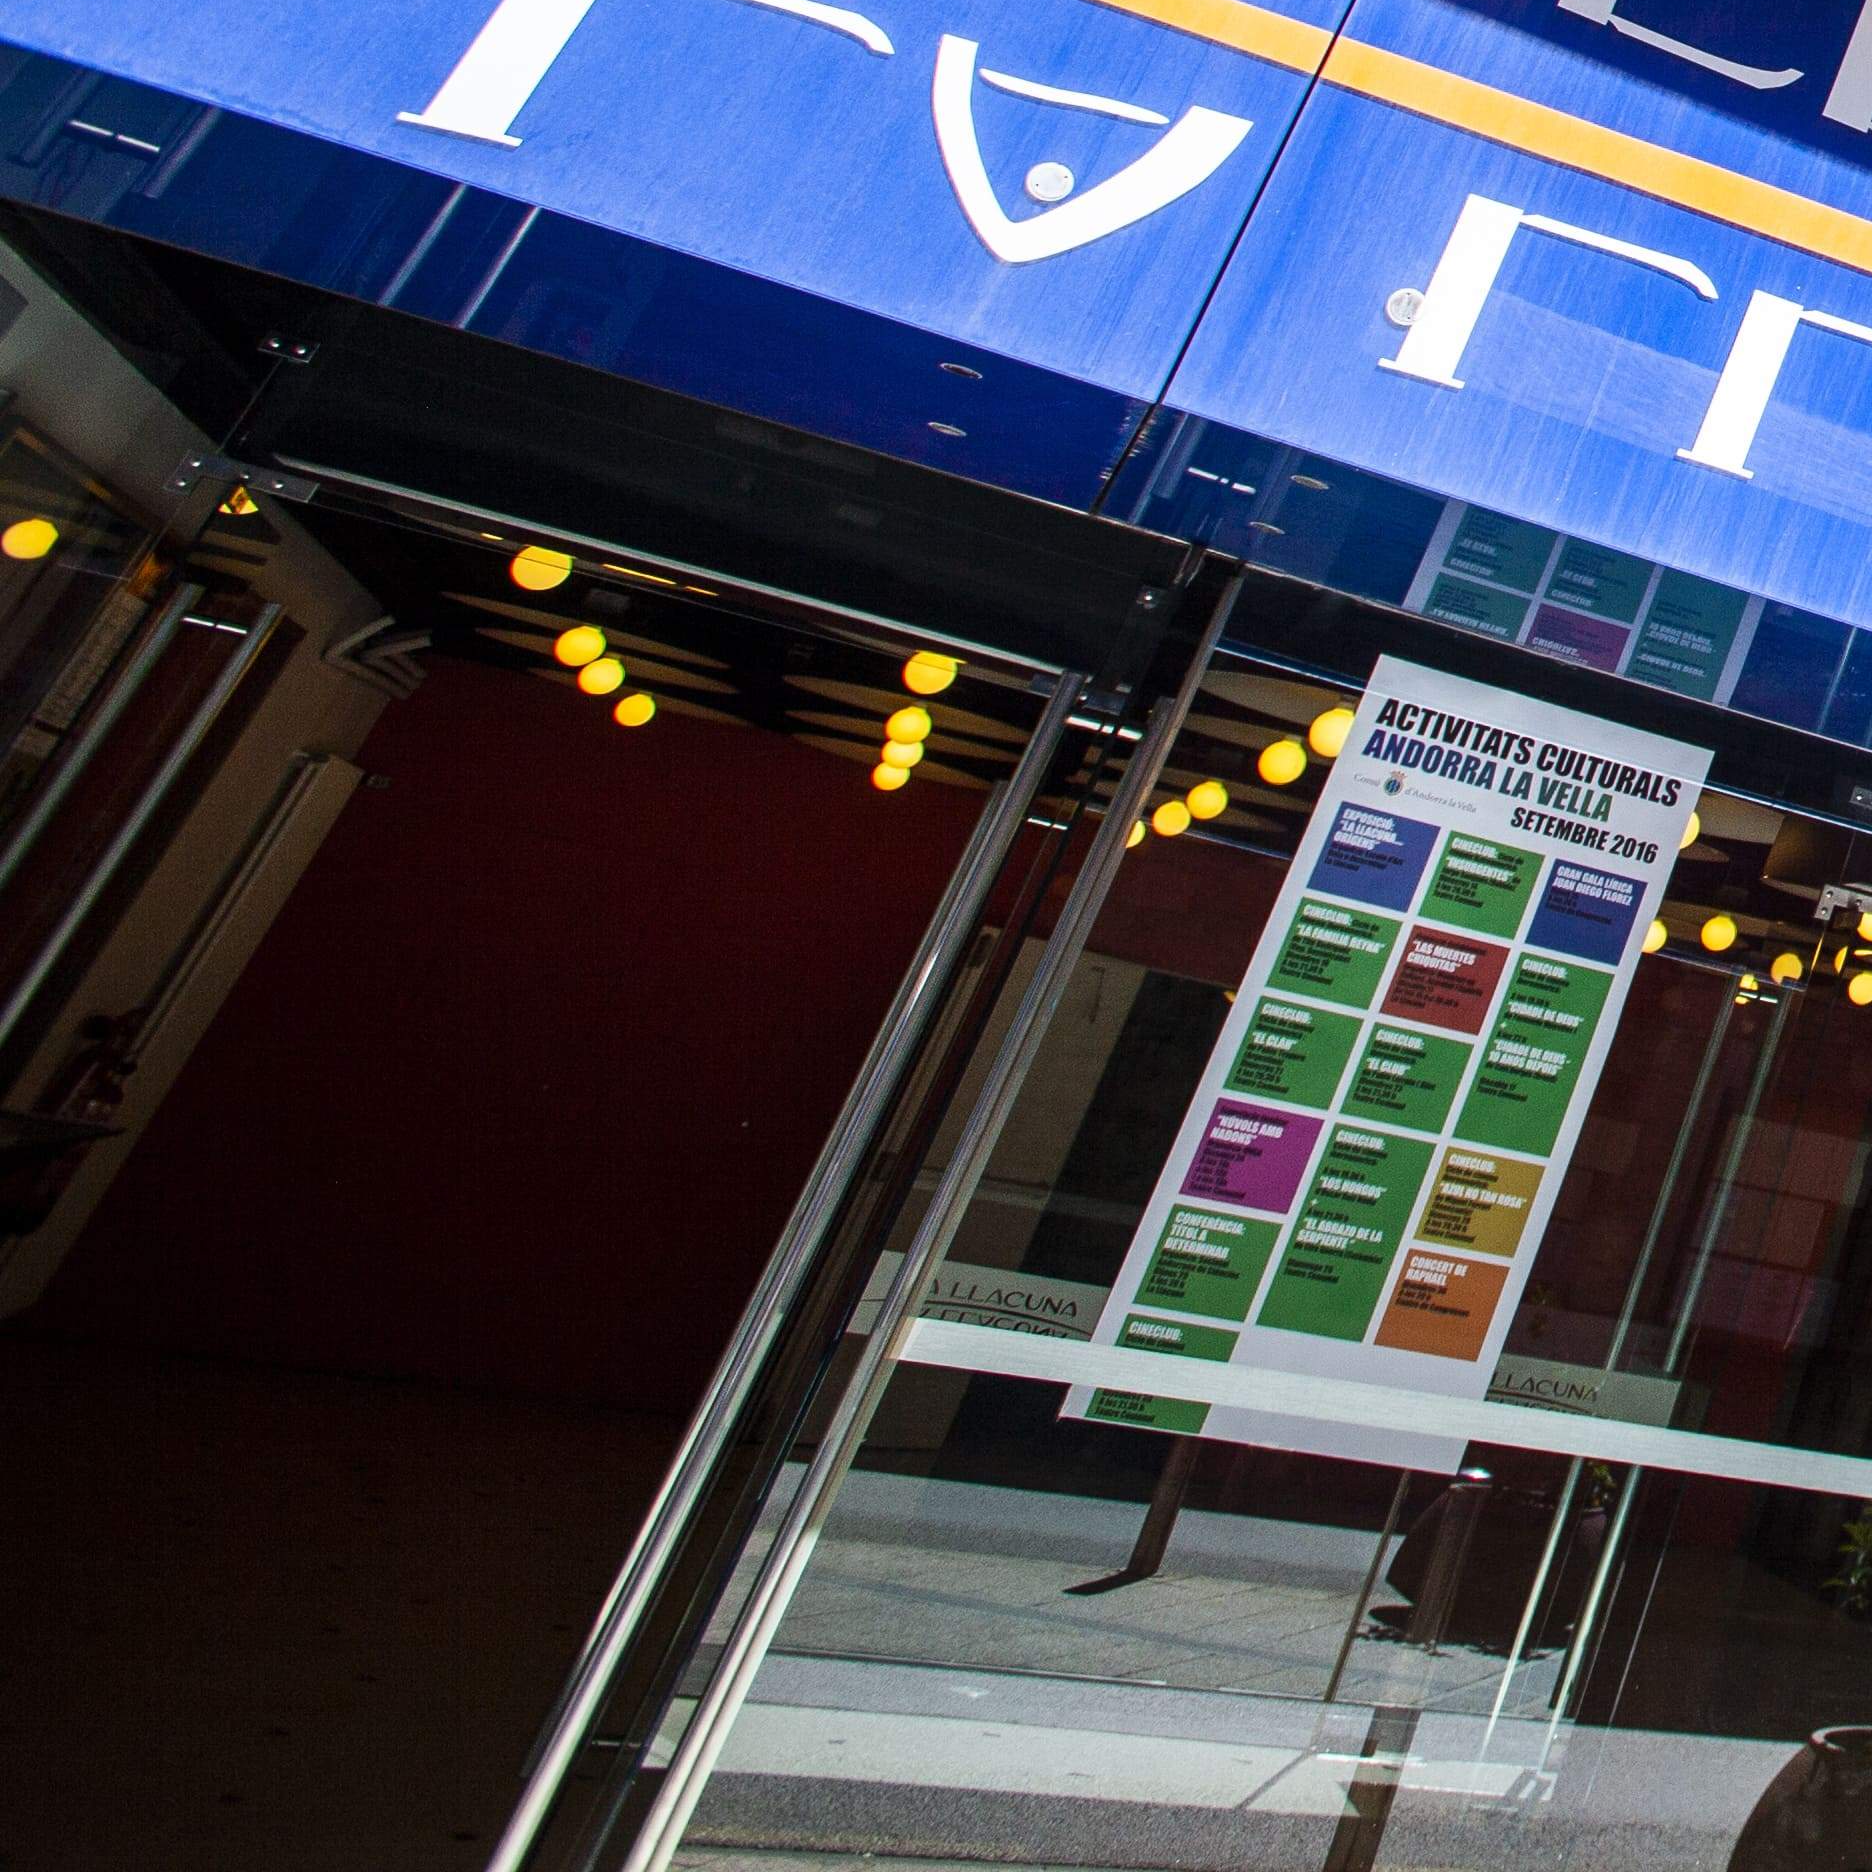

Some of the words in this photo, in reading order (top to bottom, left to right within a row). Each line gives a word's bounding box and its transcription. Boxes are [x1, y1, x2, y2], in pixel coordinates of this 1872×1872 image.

[1374, 696, 1537, 766] ACTIVITATS
[1533, 741, 1683, 808] CULTURALS
[1361, 727, 1500, 790] ANDORRA
[1498, 766, 1539, 801] LA
[1532, 776, 1616, 822] VELLA
[1508, 806, 1610, 851] SETEMBRE
[1608, 833, 1659, 864] 2016
[1551, 876, 1576, 891] JUAN
[1574, 882, 1602, 898] DIEGO
[1556, 865, 1582, 881] GRAN
[1580, 872, 1604, 886] GALA
[1409, 1255, 1452, 1273] CONCERT
[950, 1281, 1077, 1318] LLACUNA
